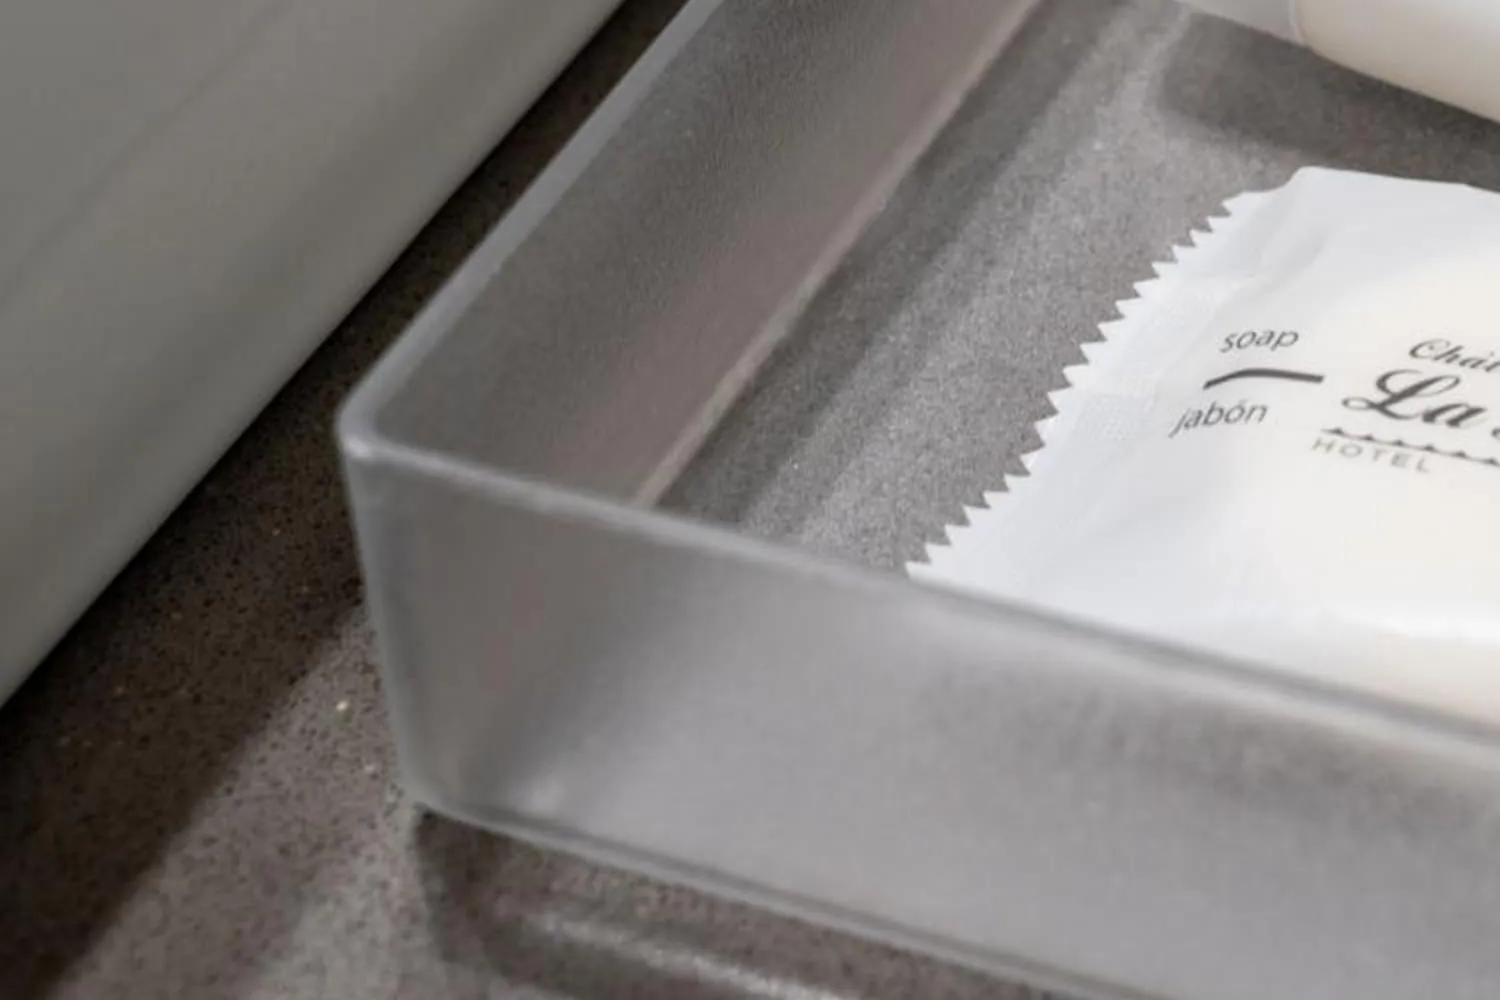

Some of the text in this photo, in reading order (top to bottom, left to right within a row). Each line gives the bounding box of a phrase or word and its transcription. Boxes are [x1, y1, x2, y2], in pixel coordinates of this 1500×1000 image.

[1218, 328, 1300, 353] soap
[1339, 368, 1490, 429] La
[1167, 400, 1269, 439] jabón
[1311, 437, 1431, 474] HOTEL
